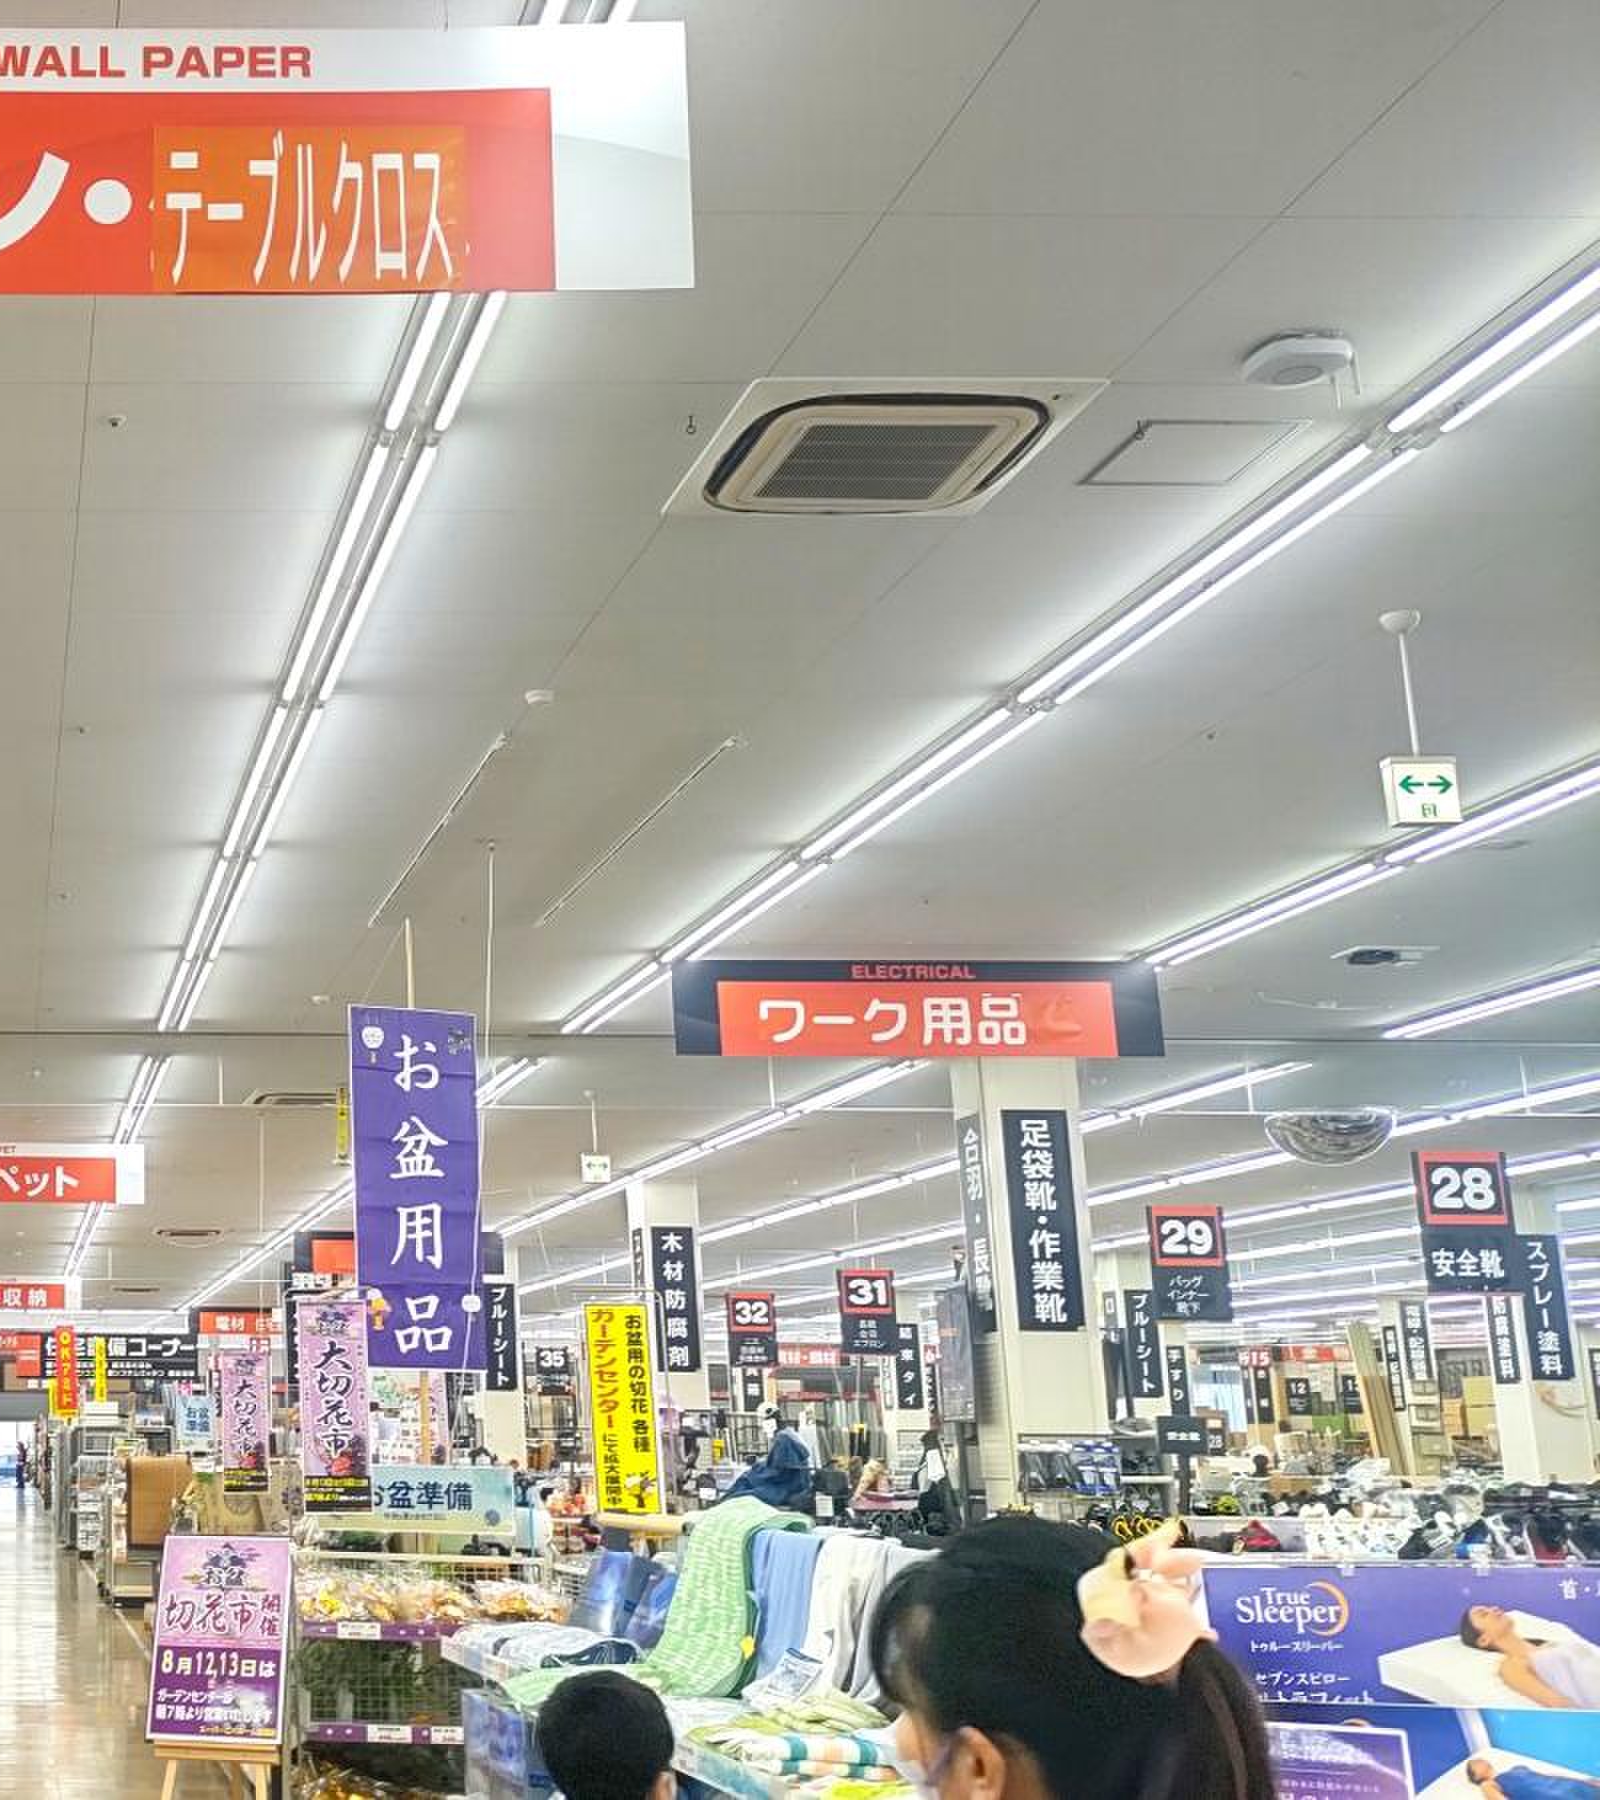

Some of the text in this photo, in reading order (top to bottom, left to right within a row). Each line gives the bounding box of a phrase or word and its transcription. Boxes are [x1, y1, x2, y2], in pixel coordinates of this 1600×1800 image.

[141, 41, 313, 81] PAPER
[850, 964, 977, 981] ELECTRICAL
[758, 992, 1028, 1046] ワーク用品
[389, 1033, 453, 1355] お盆用品
[1430, 1166, 1497, 1211] 28
[1019, 1119, 1067, 1325] 足袋靴・作業靴
[1159, 1217, 1214, 1256] 29
[1431, 1248, 1505, 1278] 安全靴
[660, 1232, 691, 1367] 木材防腐剤
[849, 1279, 887, 1305] 31
[1526, 1241, 1563, 1376] スプレー塗料
[735, 1300, 769, 1325] 32
[491, 1287, 511, 1386] ブルーシート
[1132, 1292, 1156, 1393] ブルーシート
[540, 1350, 565, 1367] 35
[1260, 1585, 1311, 1607] True
[1557, 1578, 1600, 1600] 首・
[1234, 1596, 1343, 1634] Sleeper
